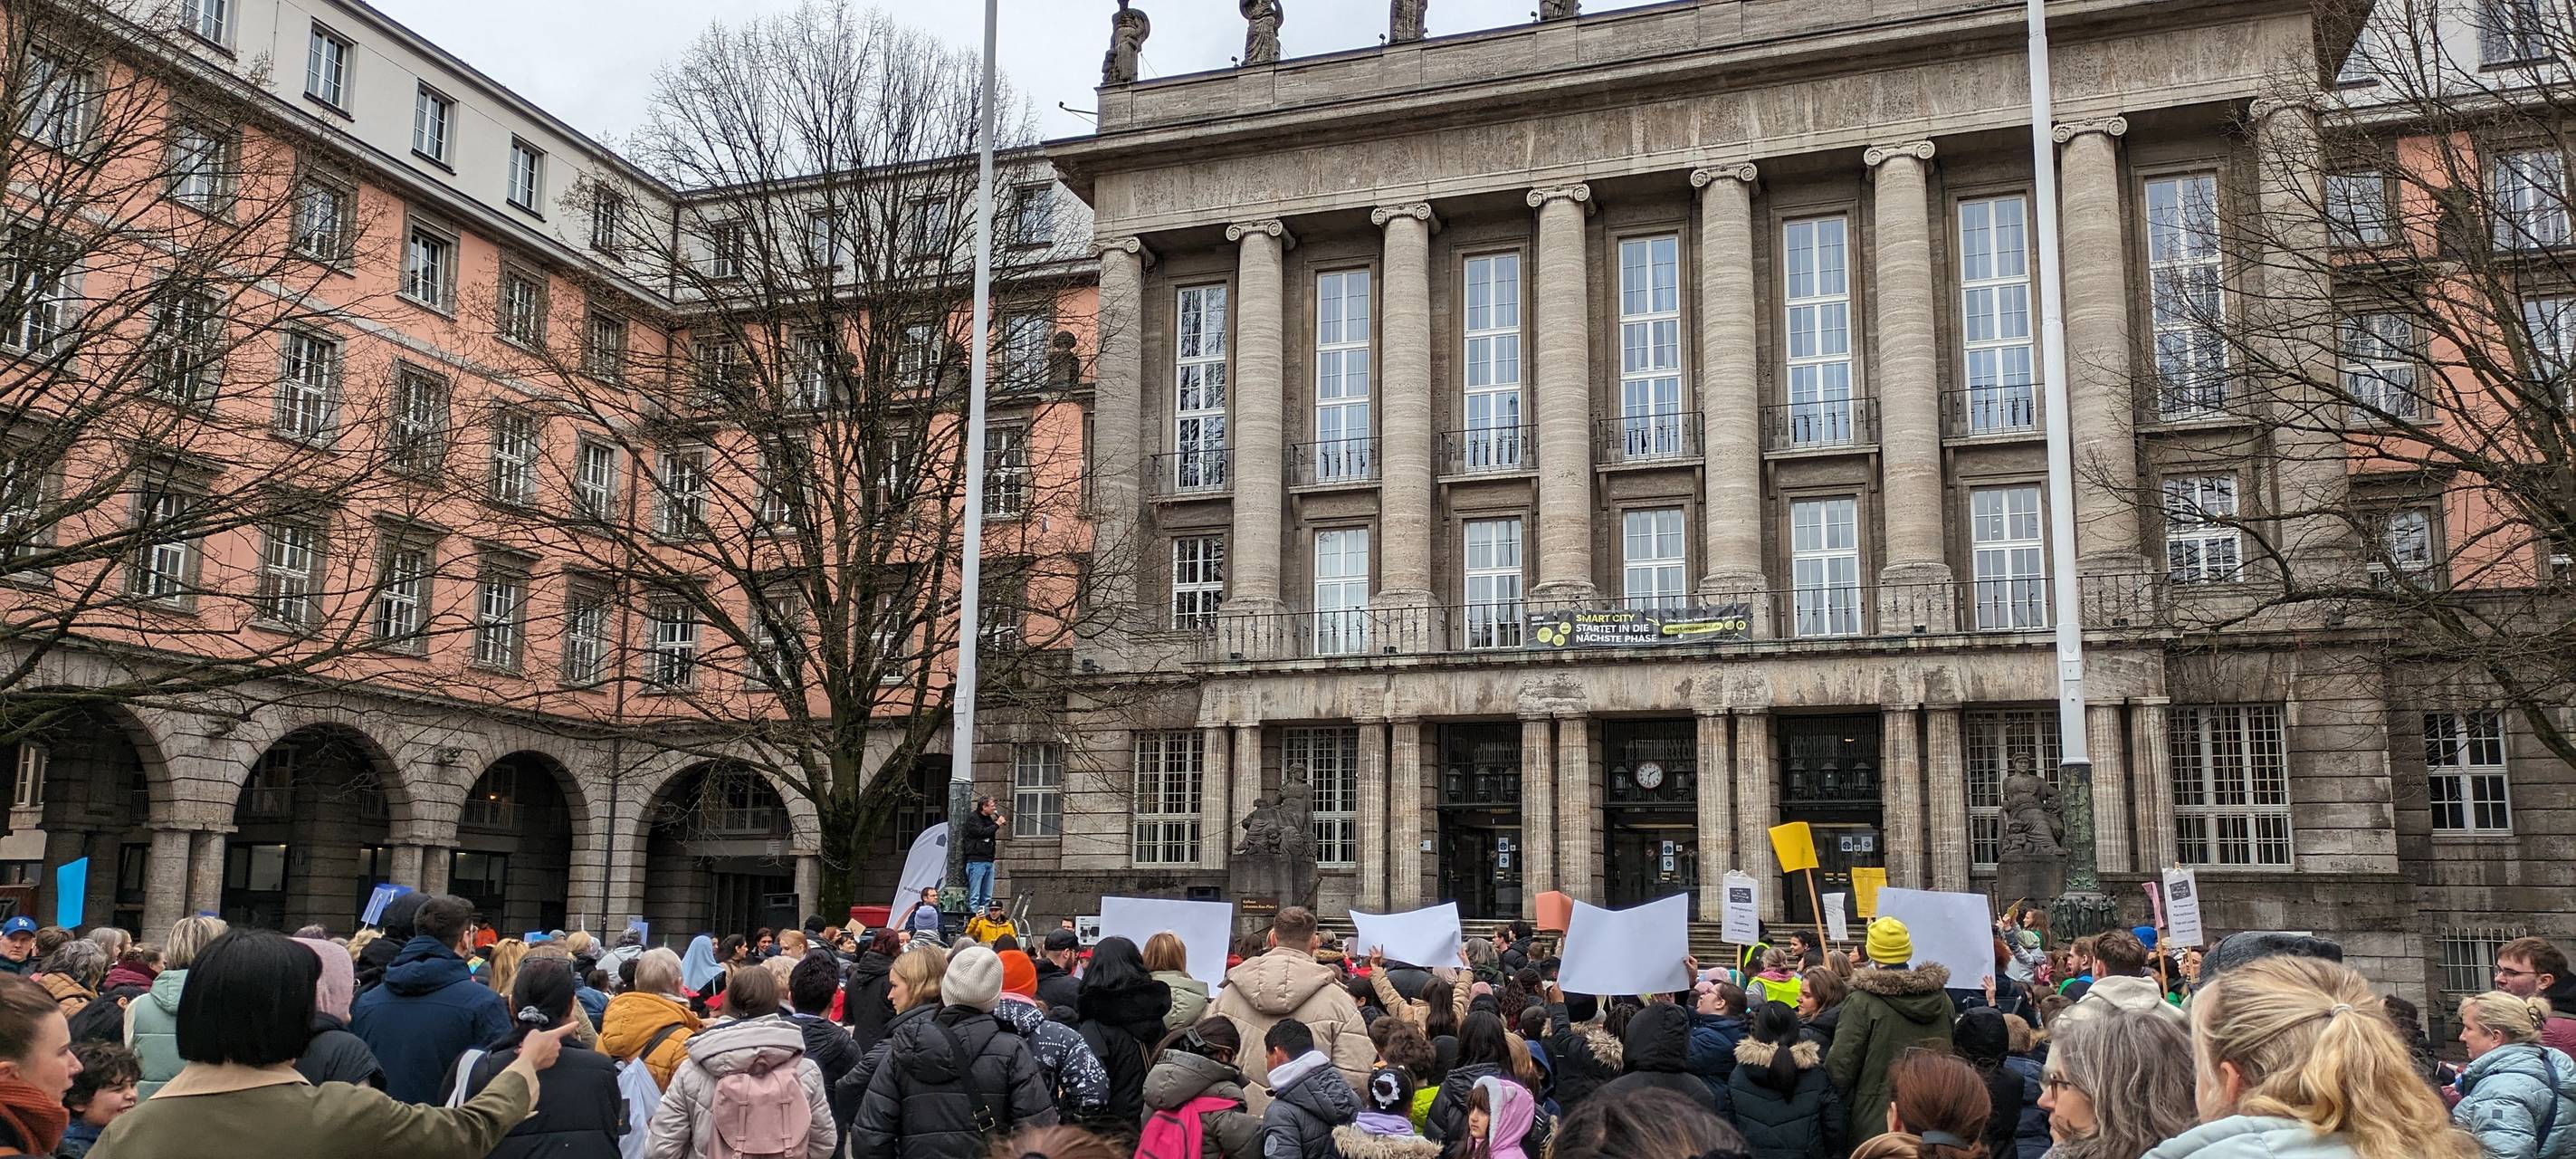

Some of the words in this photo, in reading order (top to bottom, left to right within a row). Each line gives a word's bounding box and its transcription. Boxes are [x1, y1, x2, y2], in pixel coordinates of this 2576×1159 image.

[1576, 614, 1610, 622] SMART
[1612, 614, 1635, 622] CITY
[1576, 624, 1617, 633] STARTET
[1618, 624, 1629, 632] IN
[1632, 624, 1649, 632] DIE
[1576, 632, 1622, 643] NÄCHSTE
[1625, 634, 1657, 642] PHASE
[17, 918, 28, 927] LA
